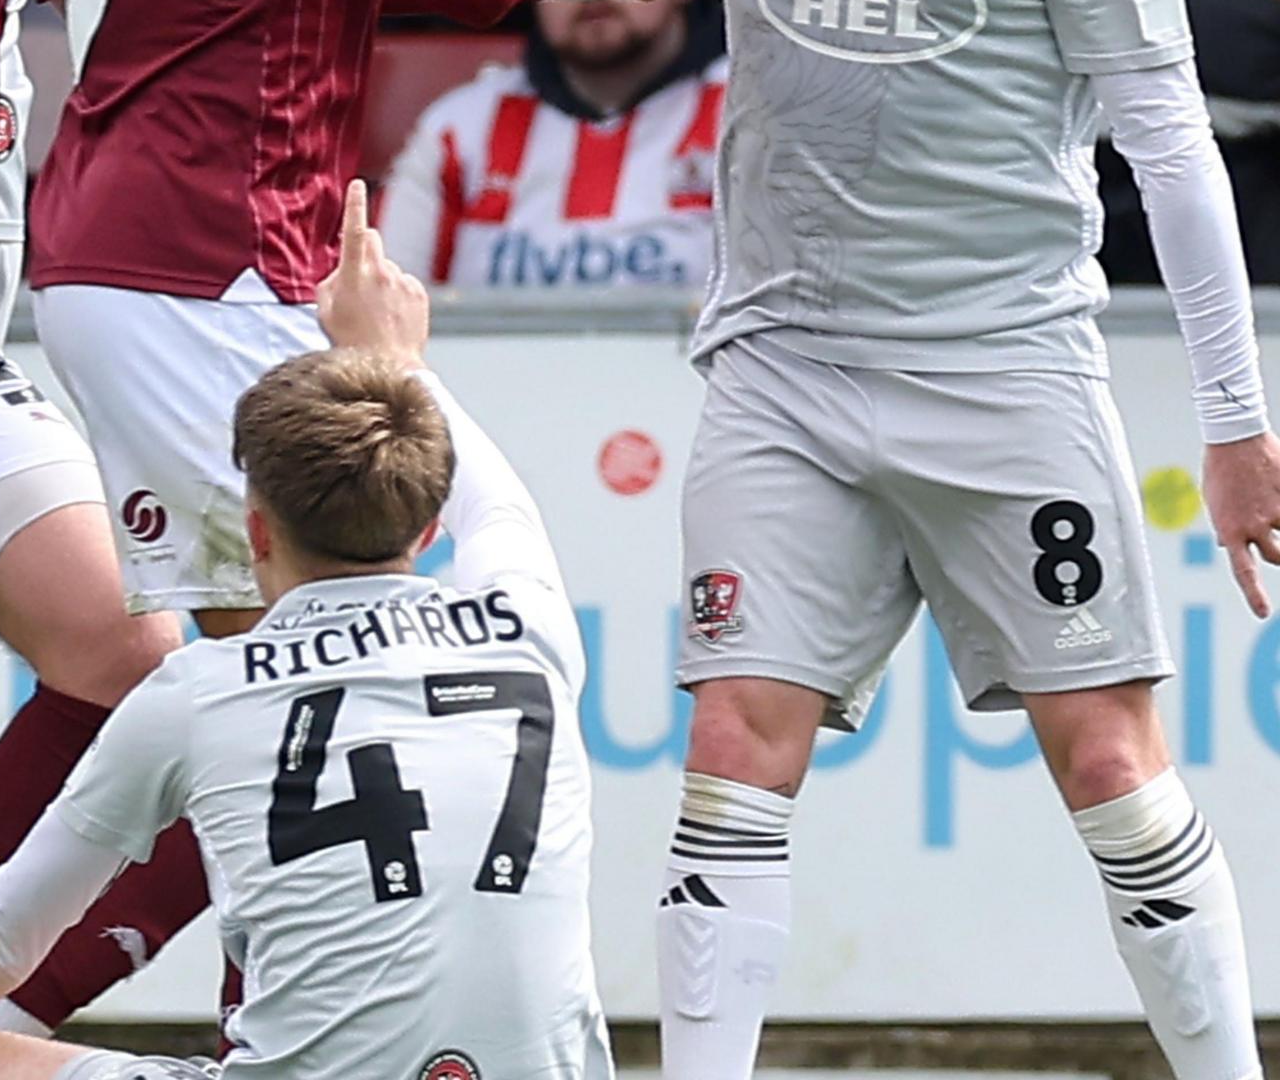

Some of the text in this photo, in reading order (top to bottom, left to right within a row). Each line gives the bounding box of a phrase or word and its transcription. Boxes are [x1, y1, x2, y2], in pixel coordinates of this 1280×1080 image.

[1031, 500, 1103, 607] 8
[244, 589, 524, 683] RICHARDS
[267, 670, 555, 903] 47
